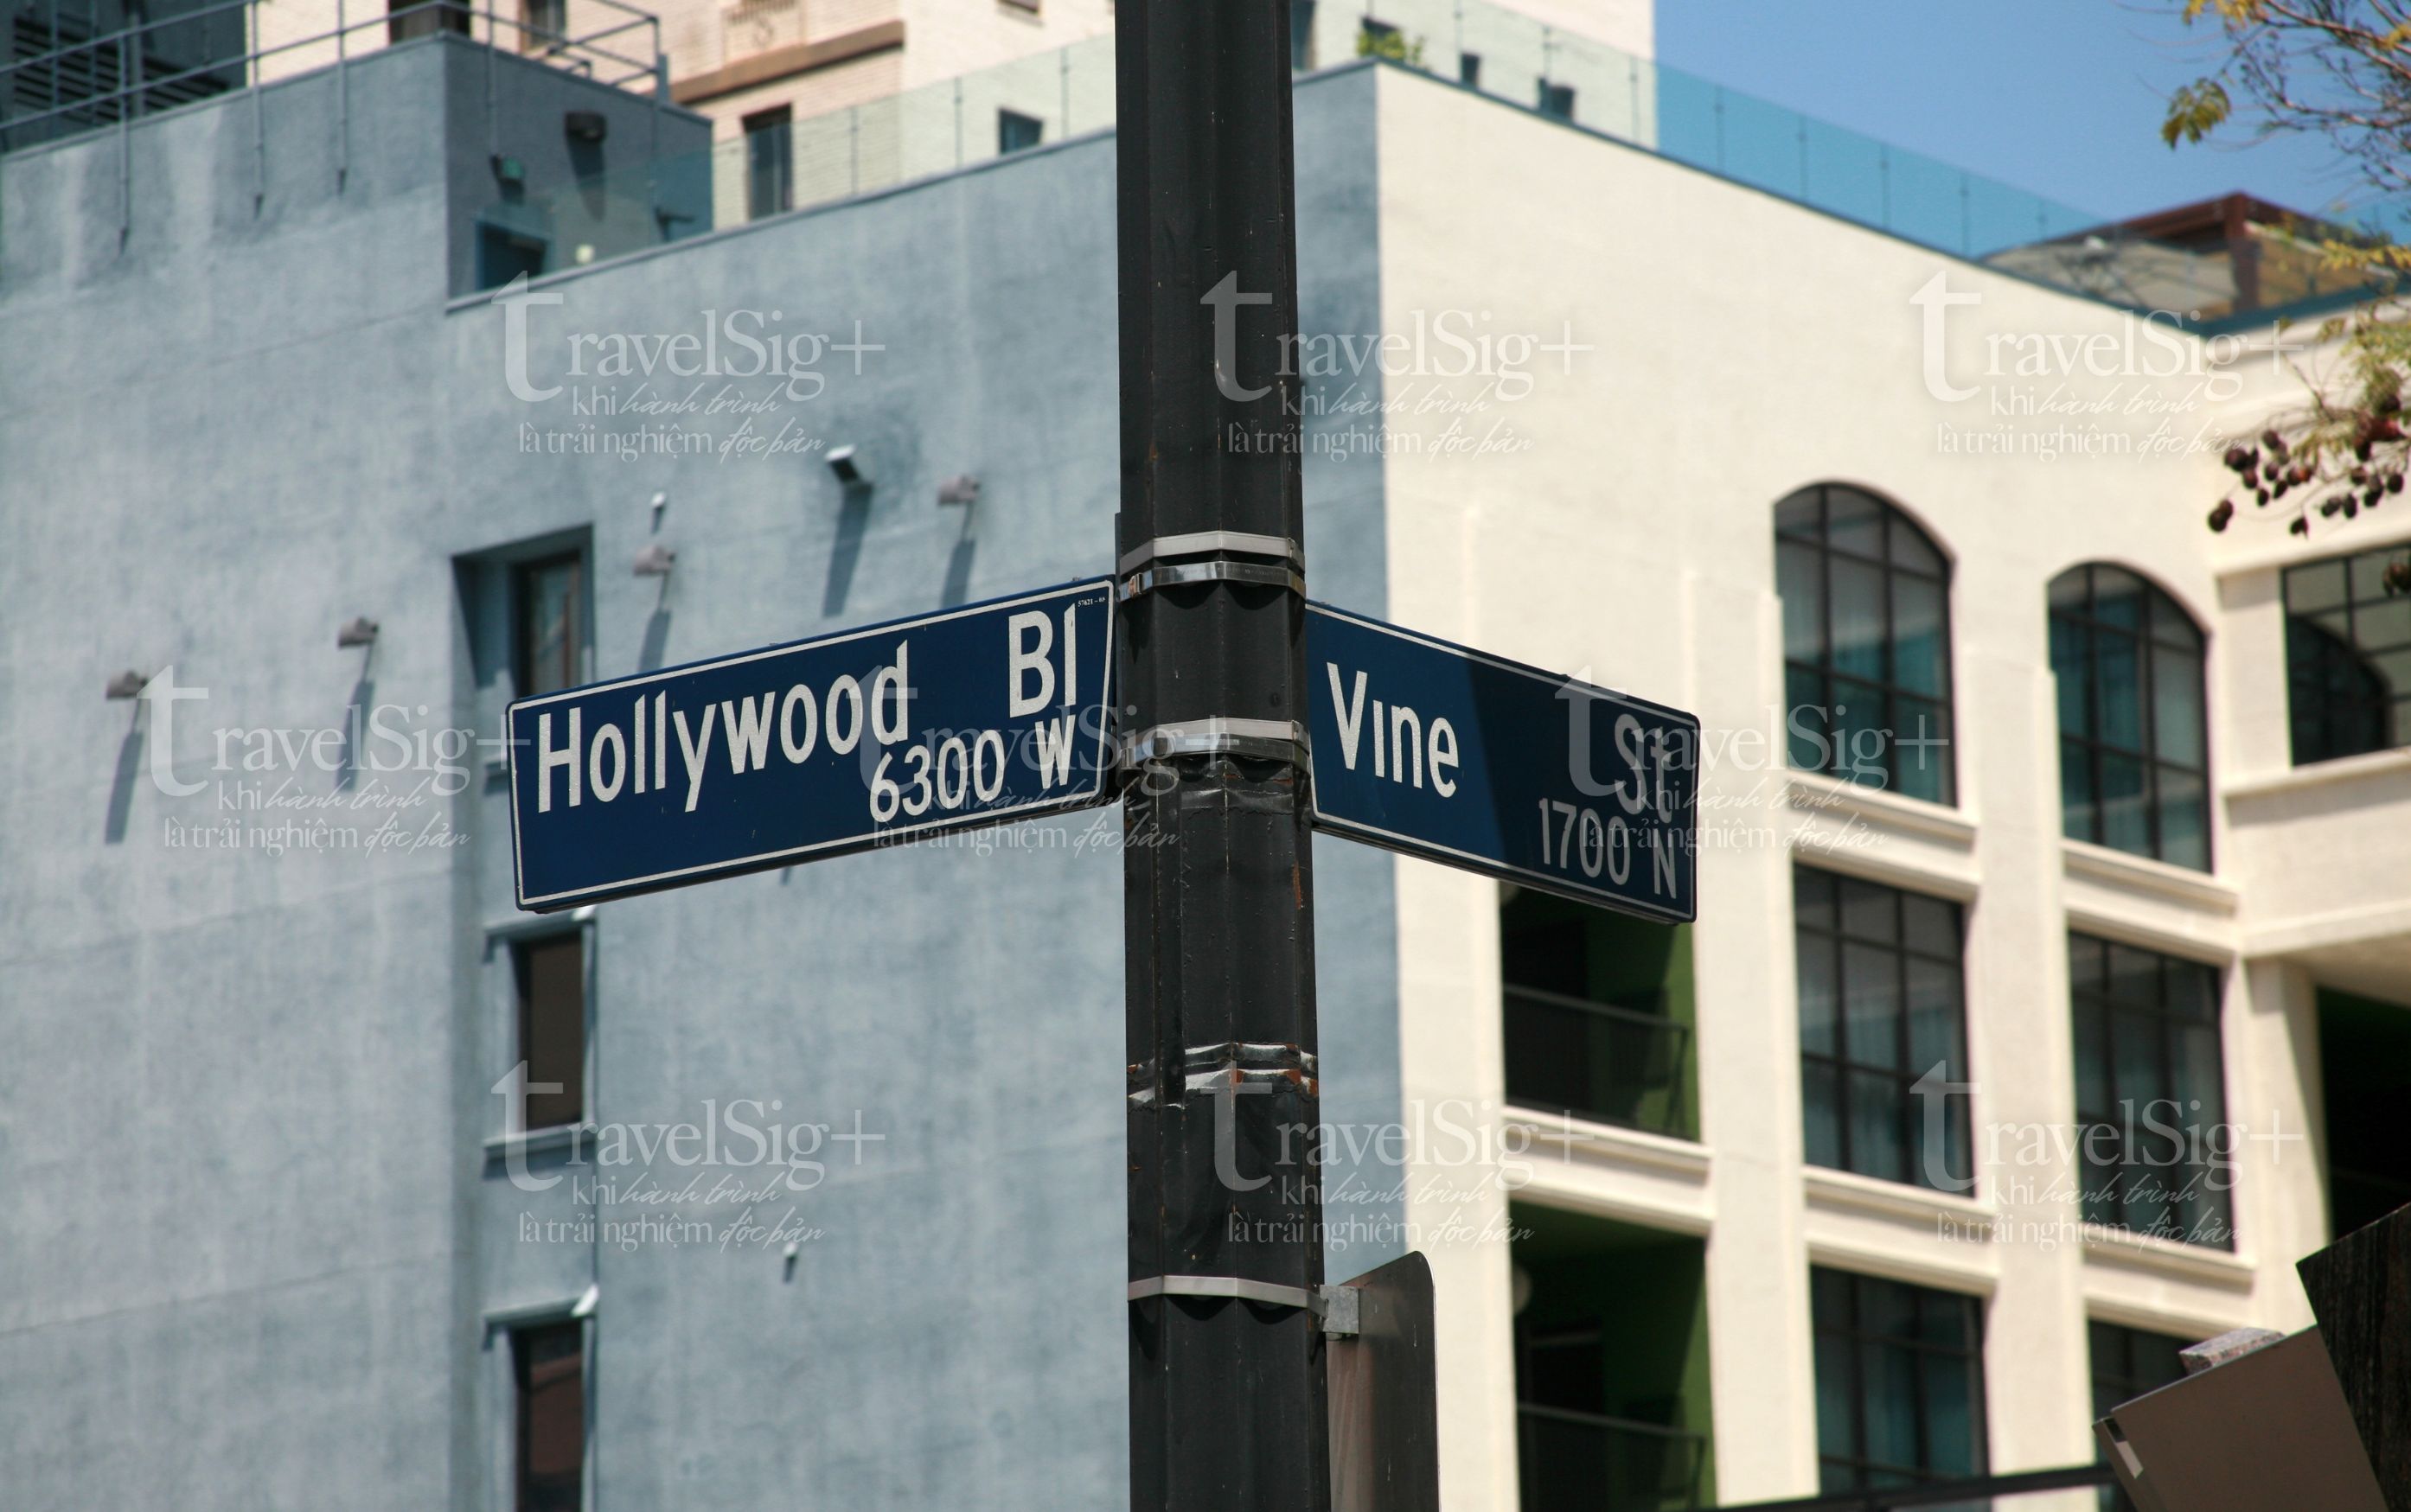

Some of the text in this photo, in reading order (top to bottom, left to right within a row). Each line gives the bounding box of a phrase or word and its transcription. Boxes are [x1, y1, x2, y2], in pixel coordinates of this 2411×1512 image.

[538, 603, 1077, 813] Hollywood Bl
[870, 714, 1076, 822] 6300 W
[1327, 662, 1672, 824] Vine St
[1538, 797, 1677, 899] 1700 N
